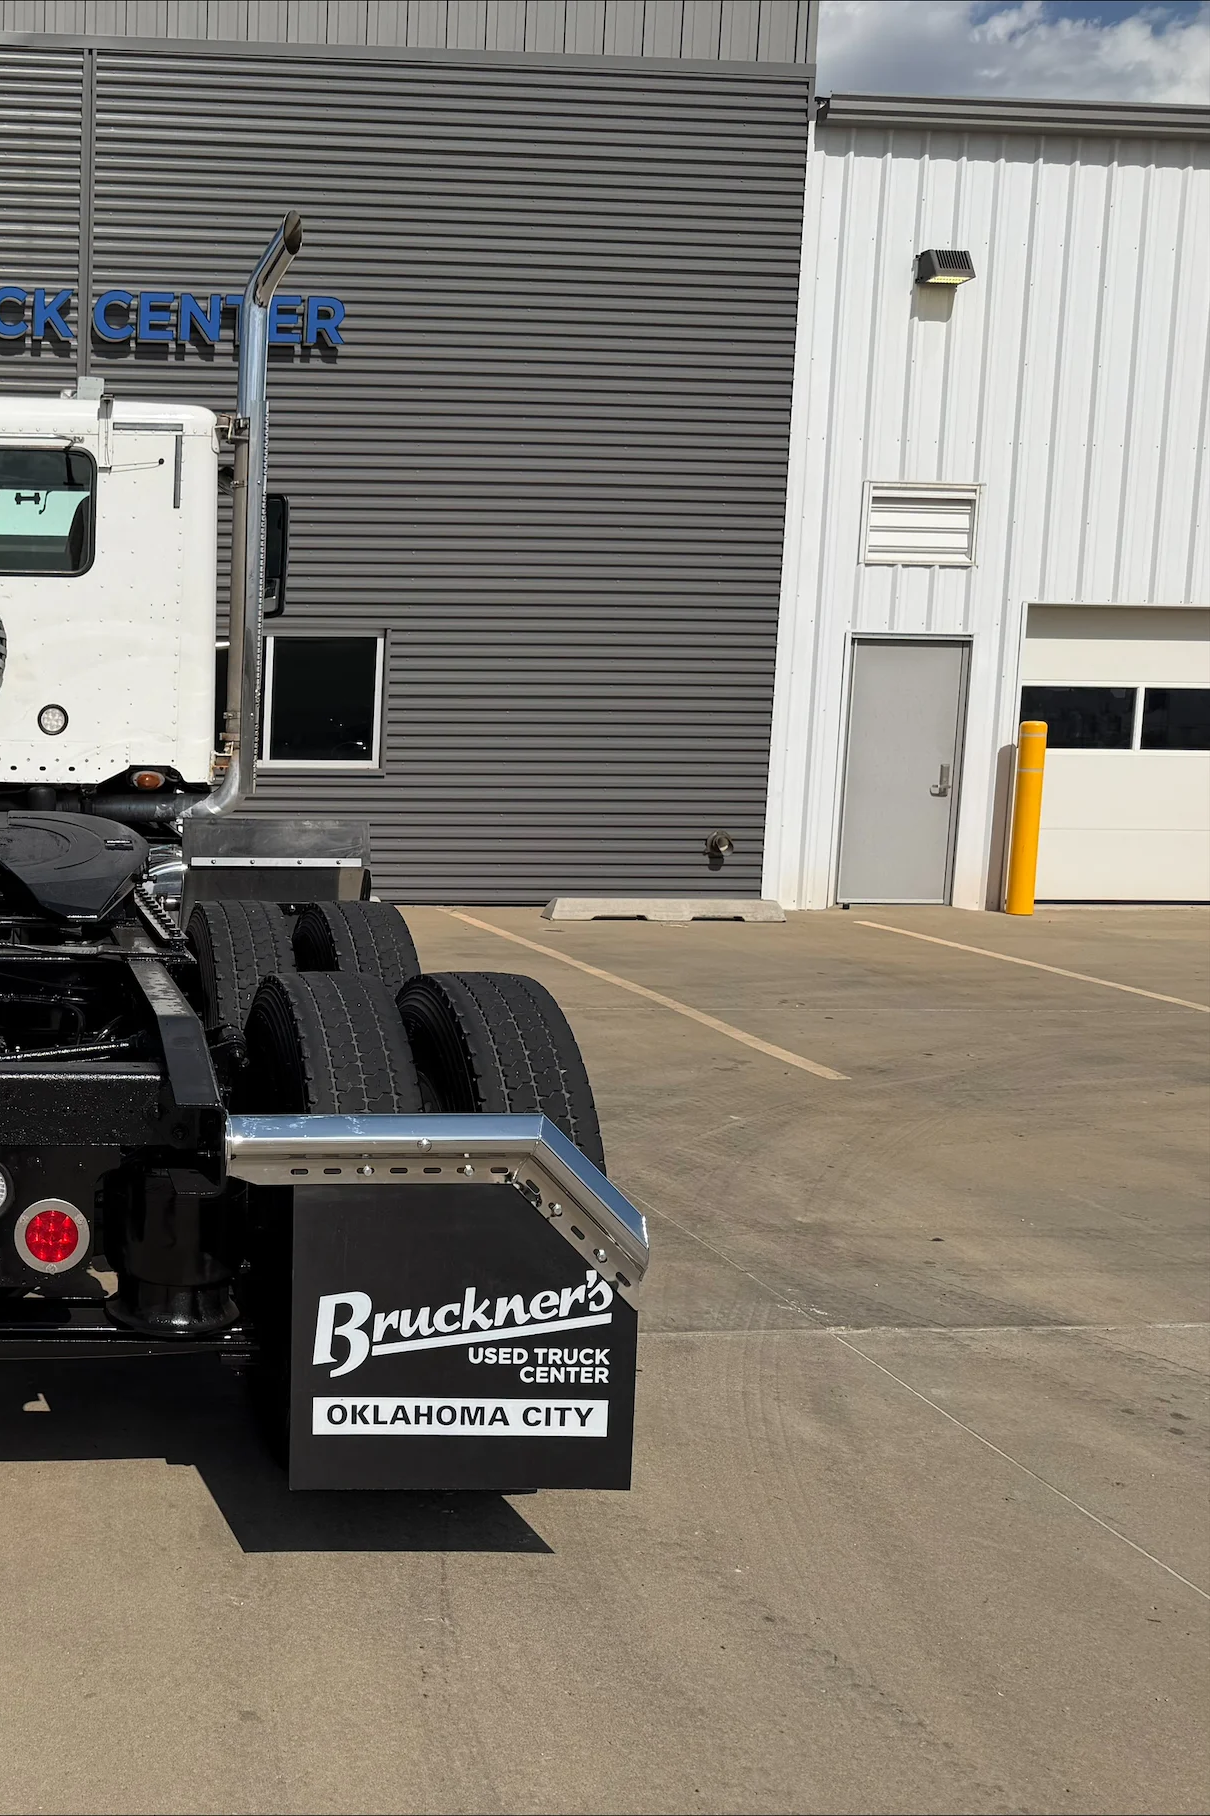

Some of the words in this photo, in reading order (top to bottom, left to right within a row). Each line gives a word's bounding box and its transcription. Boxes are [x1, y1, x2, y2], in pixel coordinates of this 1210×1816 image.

[312, 1270, 614, 1378] Bruckner's
[468, 1347, 528, 1365] USED
[533, 1348, 610, 1366] TRUCK
[519, 1366, 609, 1384] CENTER
[326, 1404, 510, 1426] OKLAHOMA
[522, 1406, 594, 1427] CITY
